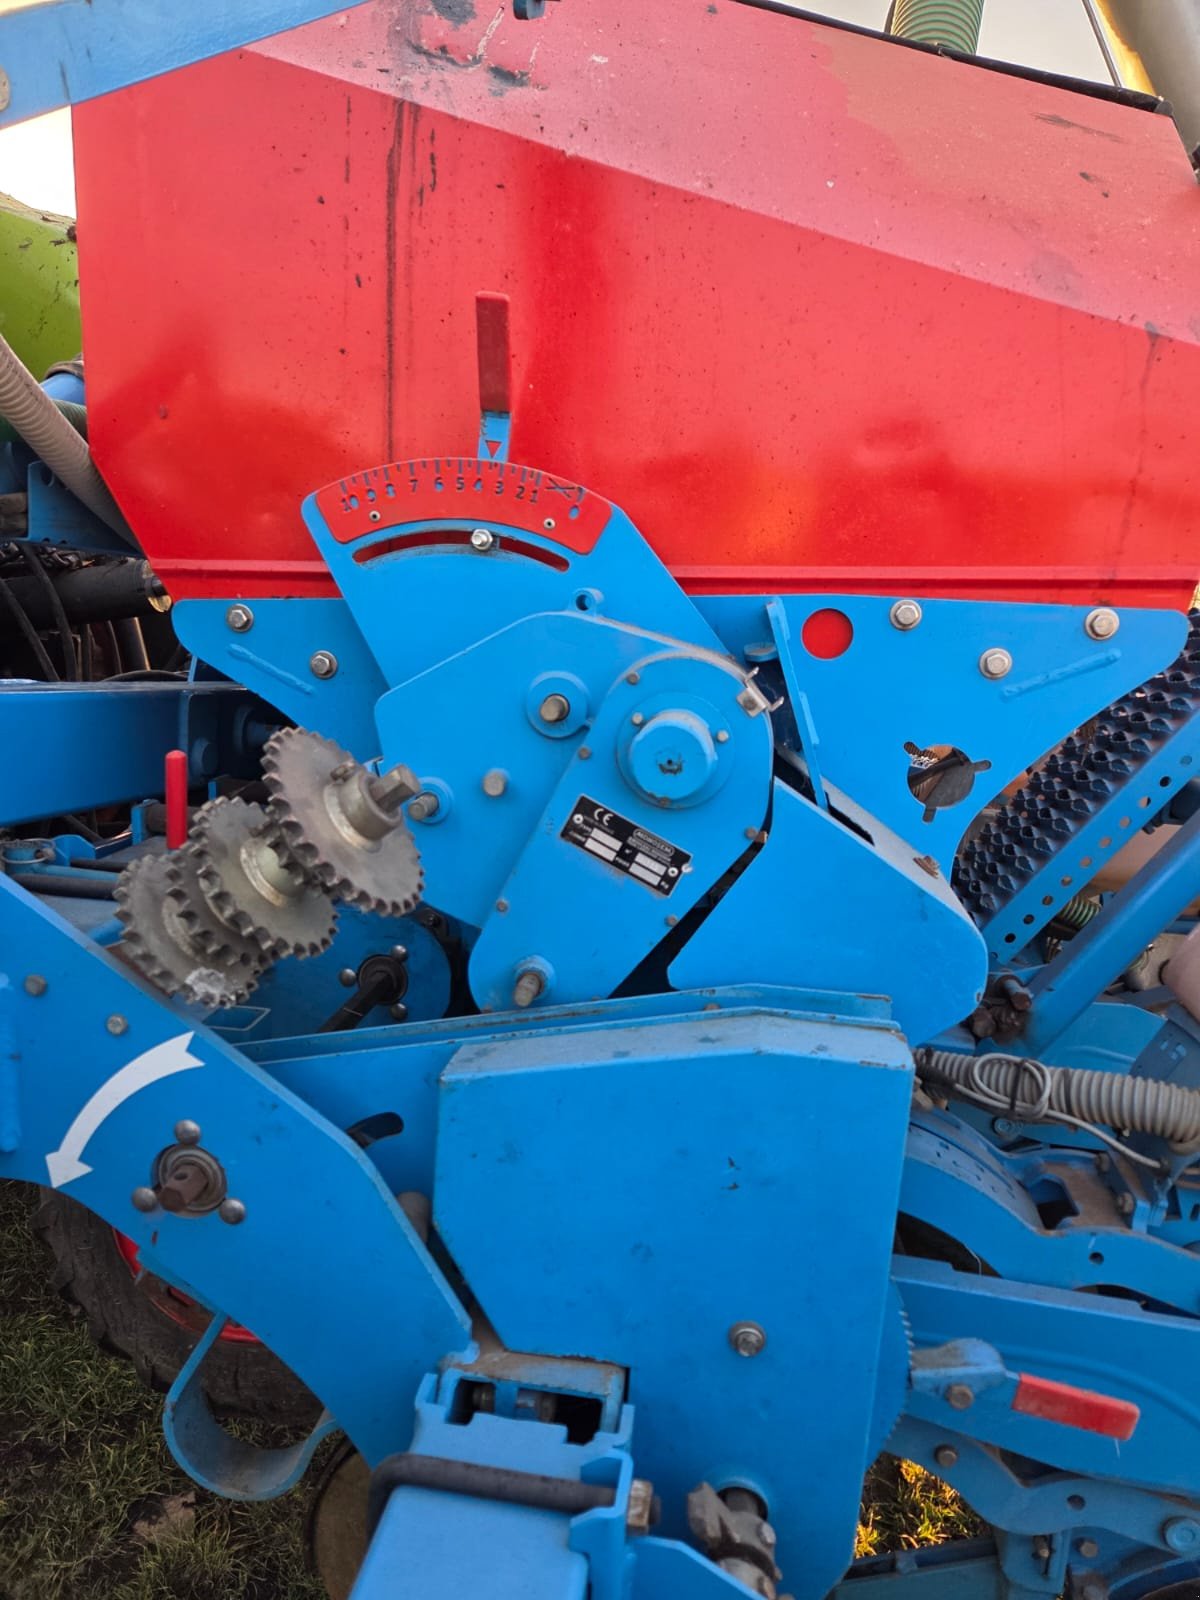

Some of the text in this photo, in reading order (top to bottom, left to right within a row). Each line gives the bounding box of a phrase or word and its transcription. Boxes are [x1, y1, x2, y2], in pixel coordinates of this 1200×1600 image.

[340, 494, 359, 512] 10
[367, 488, 376, 503] 9
[386, 483, 396, 497] 8
[409, 478, 418, 493] 7
[434, 476, 444, 491] 6
[456, 476, 465, 491] 5
[474, 477, 483, 491] 4
[495, 480, 504, 495] 3
[515, 485, 525, 500] 2
[529, 489, 538, 504] 1
[594, 808, 614, 826] CE
[635, 830, 673, 854] MONOSEM
